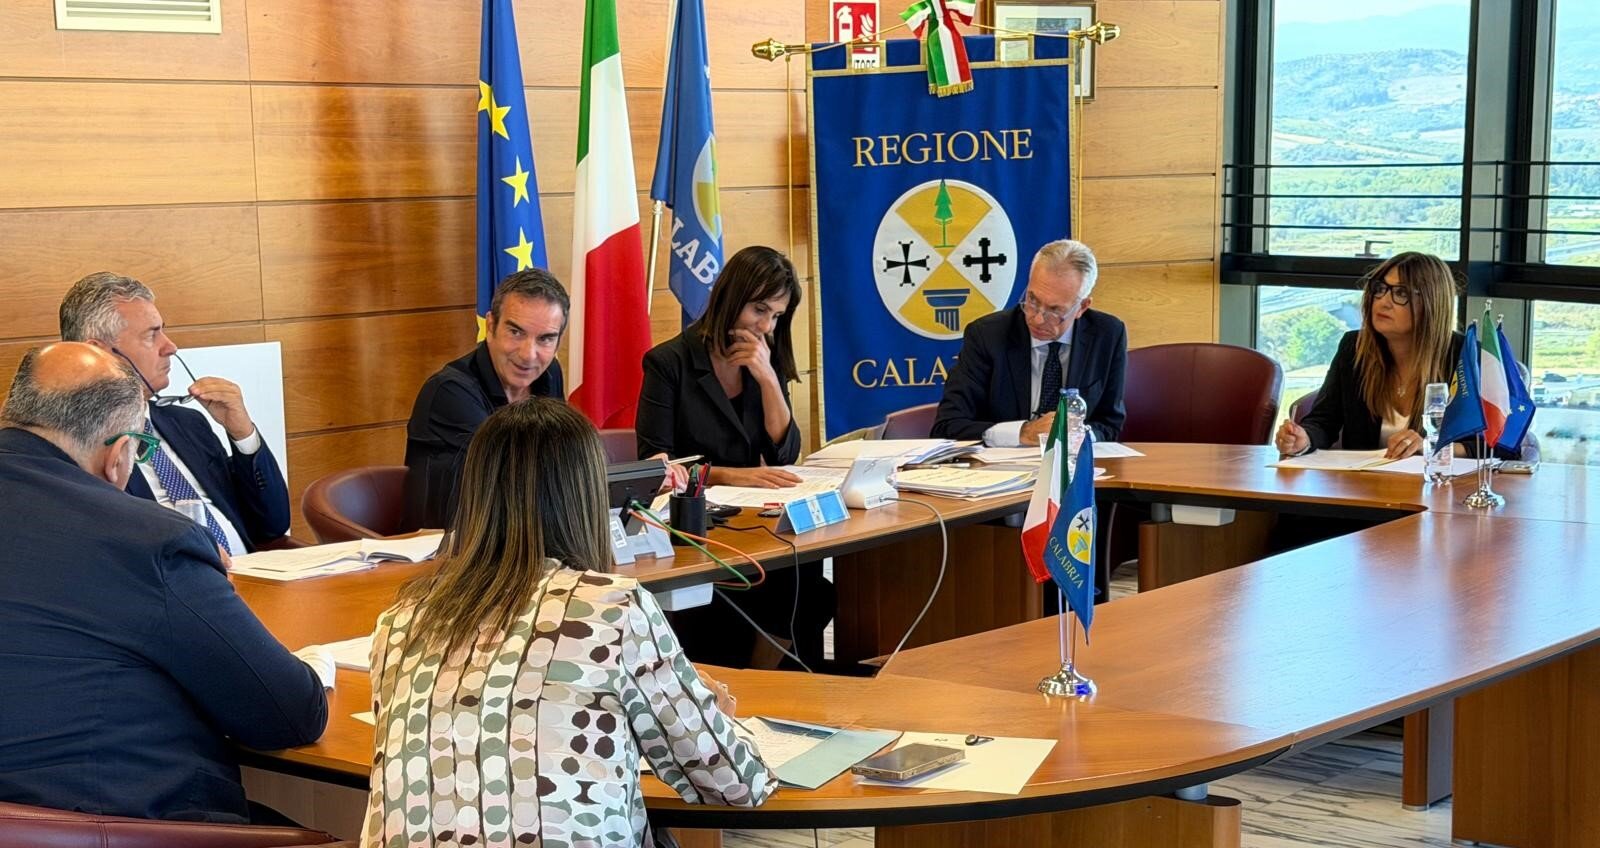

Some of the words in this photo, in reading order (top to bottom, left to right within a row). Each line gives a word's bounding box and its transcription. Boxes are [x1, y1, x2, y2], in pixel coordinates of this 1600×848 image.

[852, 128, 1033, 167] REGIONE
[672, 217, 719, 291] LAB
[852, 355, 959, 388] CALA
[1050, 536, 1084, 589] CALABRIA
